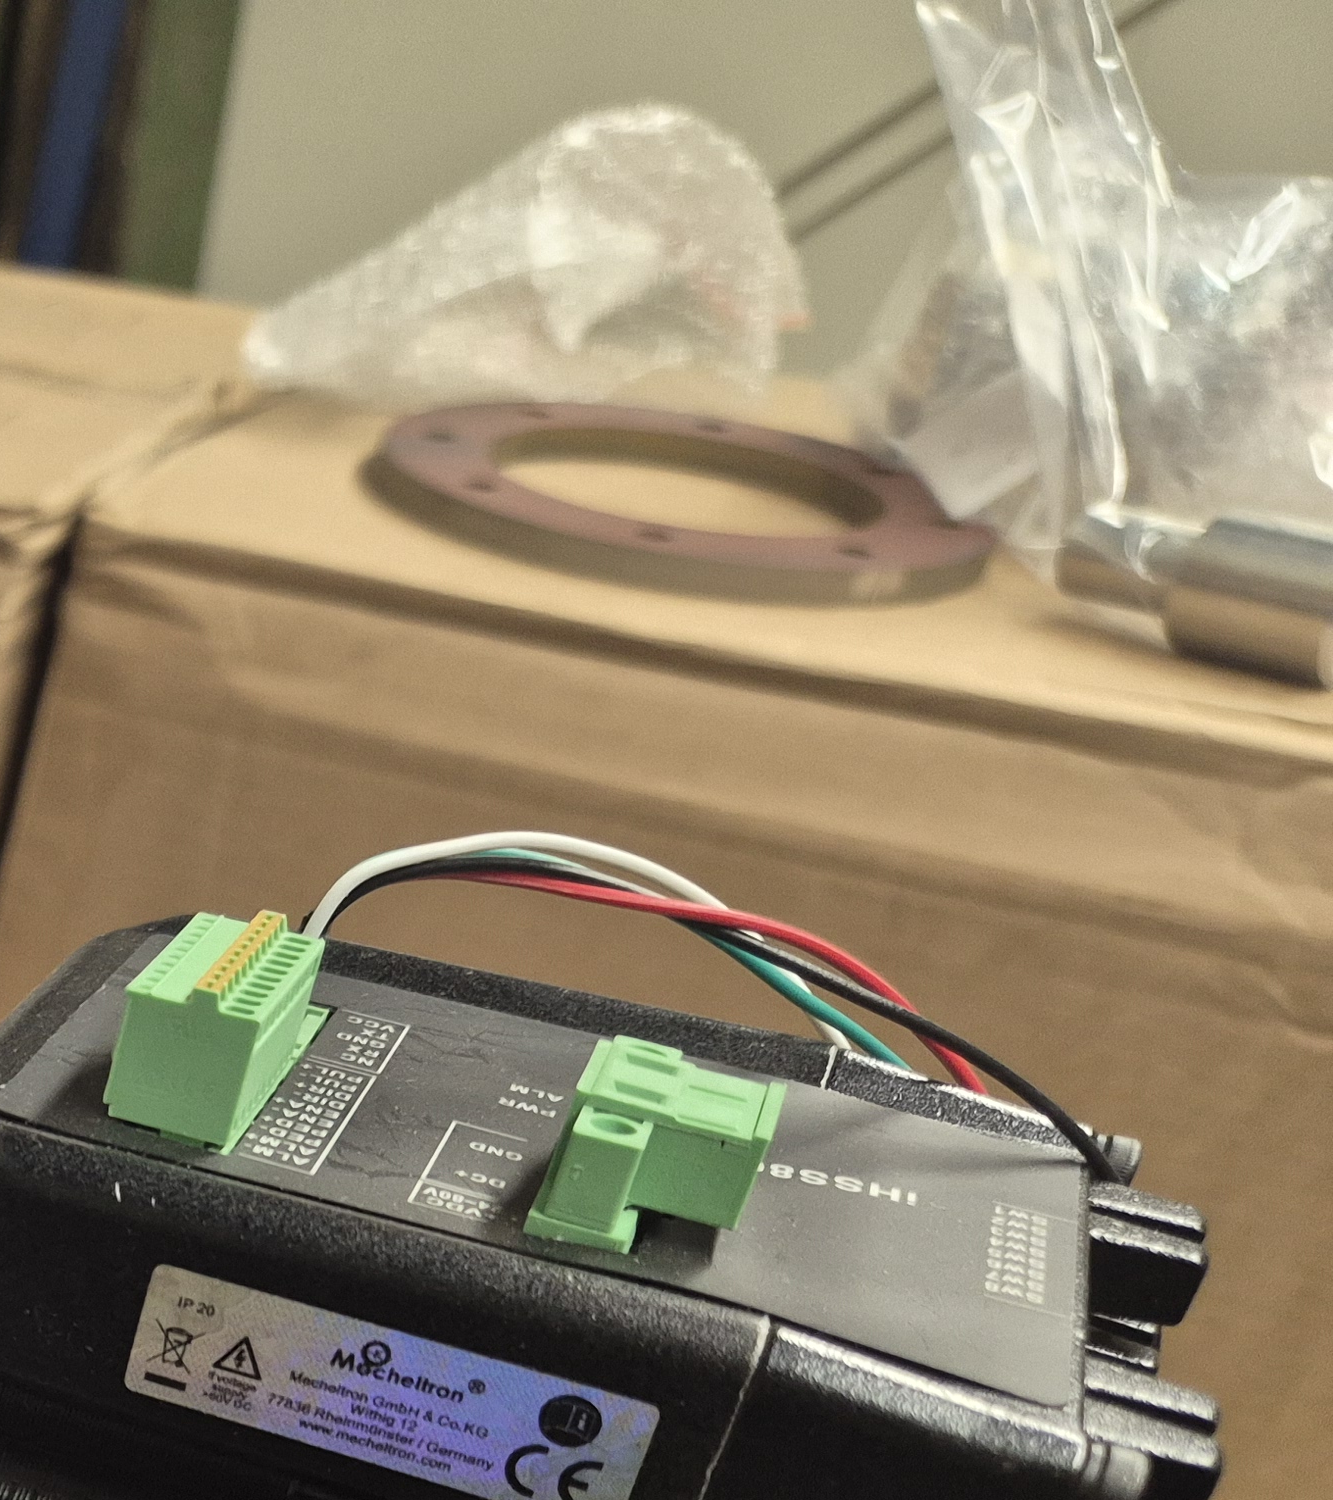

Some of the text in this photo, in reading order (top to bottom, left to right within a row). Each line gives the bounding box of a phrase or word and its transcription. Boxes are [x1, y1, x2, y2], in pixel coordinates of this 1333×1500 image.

[347, 1015, 395, 1033] VCC
[360, 1028, 389, 1041] TX
[336, 1032, 386, 1049] GND
[346, 1044, 380, 1058] RX
[299, 1072, 358, 1092] PUL-
[301, 1064, 364, 1084] PUL+
[293, 1090, 346, 1111] DIR-
[294, 1081, 352, 1102] DIR+
[510, 1083, 564, 1102] ALM
[271, 1106, 334, 1129] ENA-
[273, 1096, 340, 1120] ENA+
[498, 1096, 557, 1118] PWR
[260, 1124, 322, 1148] PED-
[261, 1115, 329, 1138] PED+
[244, 1142, 311, 1166] ALM-
[245, 1132, 317, 1155] ALM+
[469, 1141, 523, 1162] GND
[454, 1169, 507, 1189] DC+
[177, 1296, 215, 1317] IP 20
[289, 1370, 369, 1403] Mecheltron
[373, 1396, 420, 1417] GmbH
[422, 1410, 433, 1423] &
[351, 1403, 418, 1433] Withig 12
[299, 1419, 452, 1473] www.mecheltron.com
[314, 1406, 415, 1446] Rheinmünster
[417, 1438, 424, 1449] /
[426, 1441, 494, 1471] Germany
